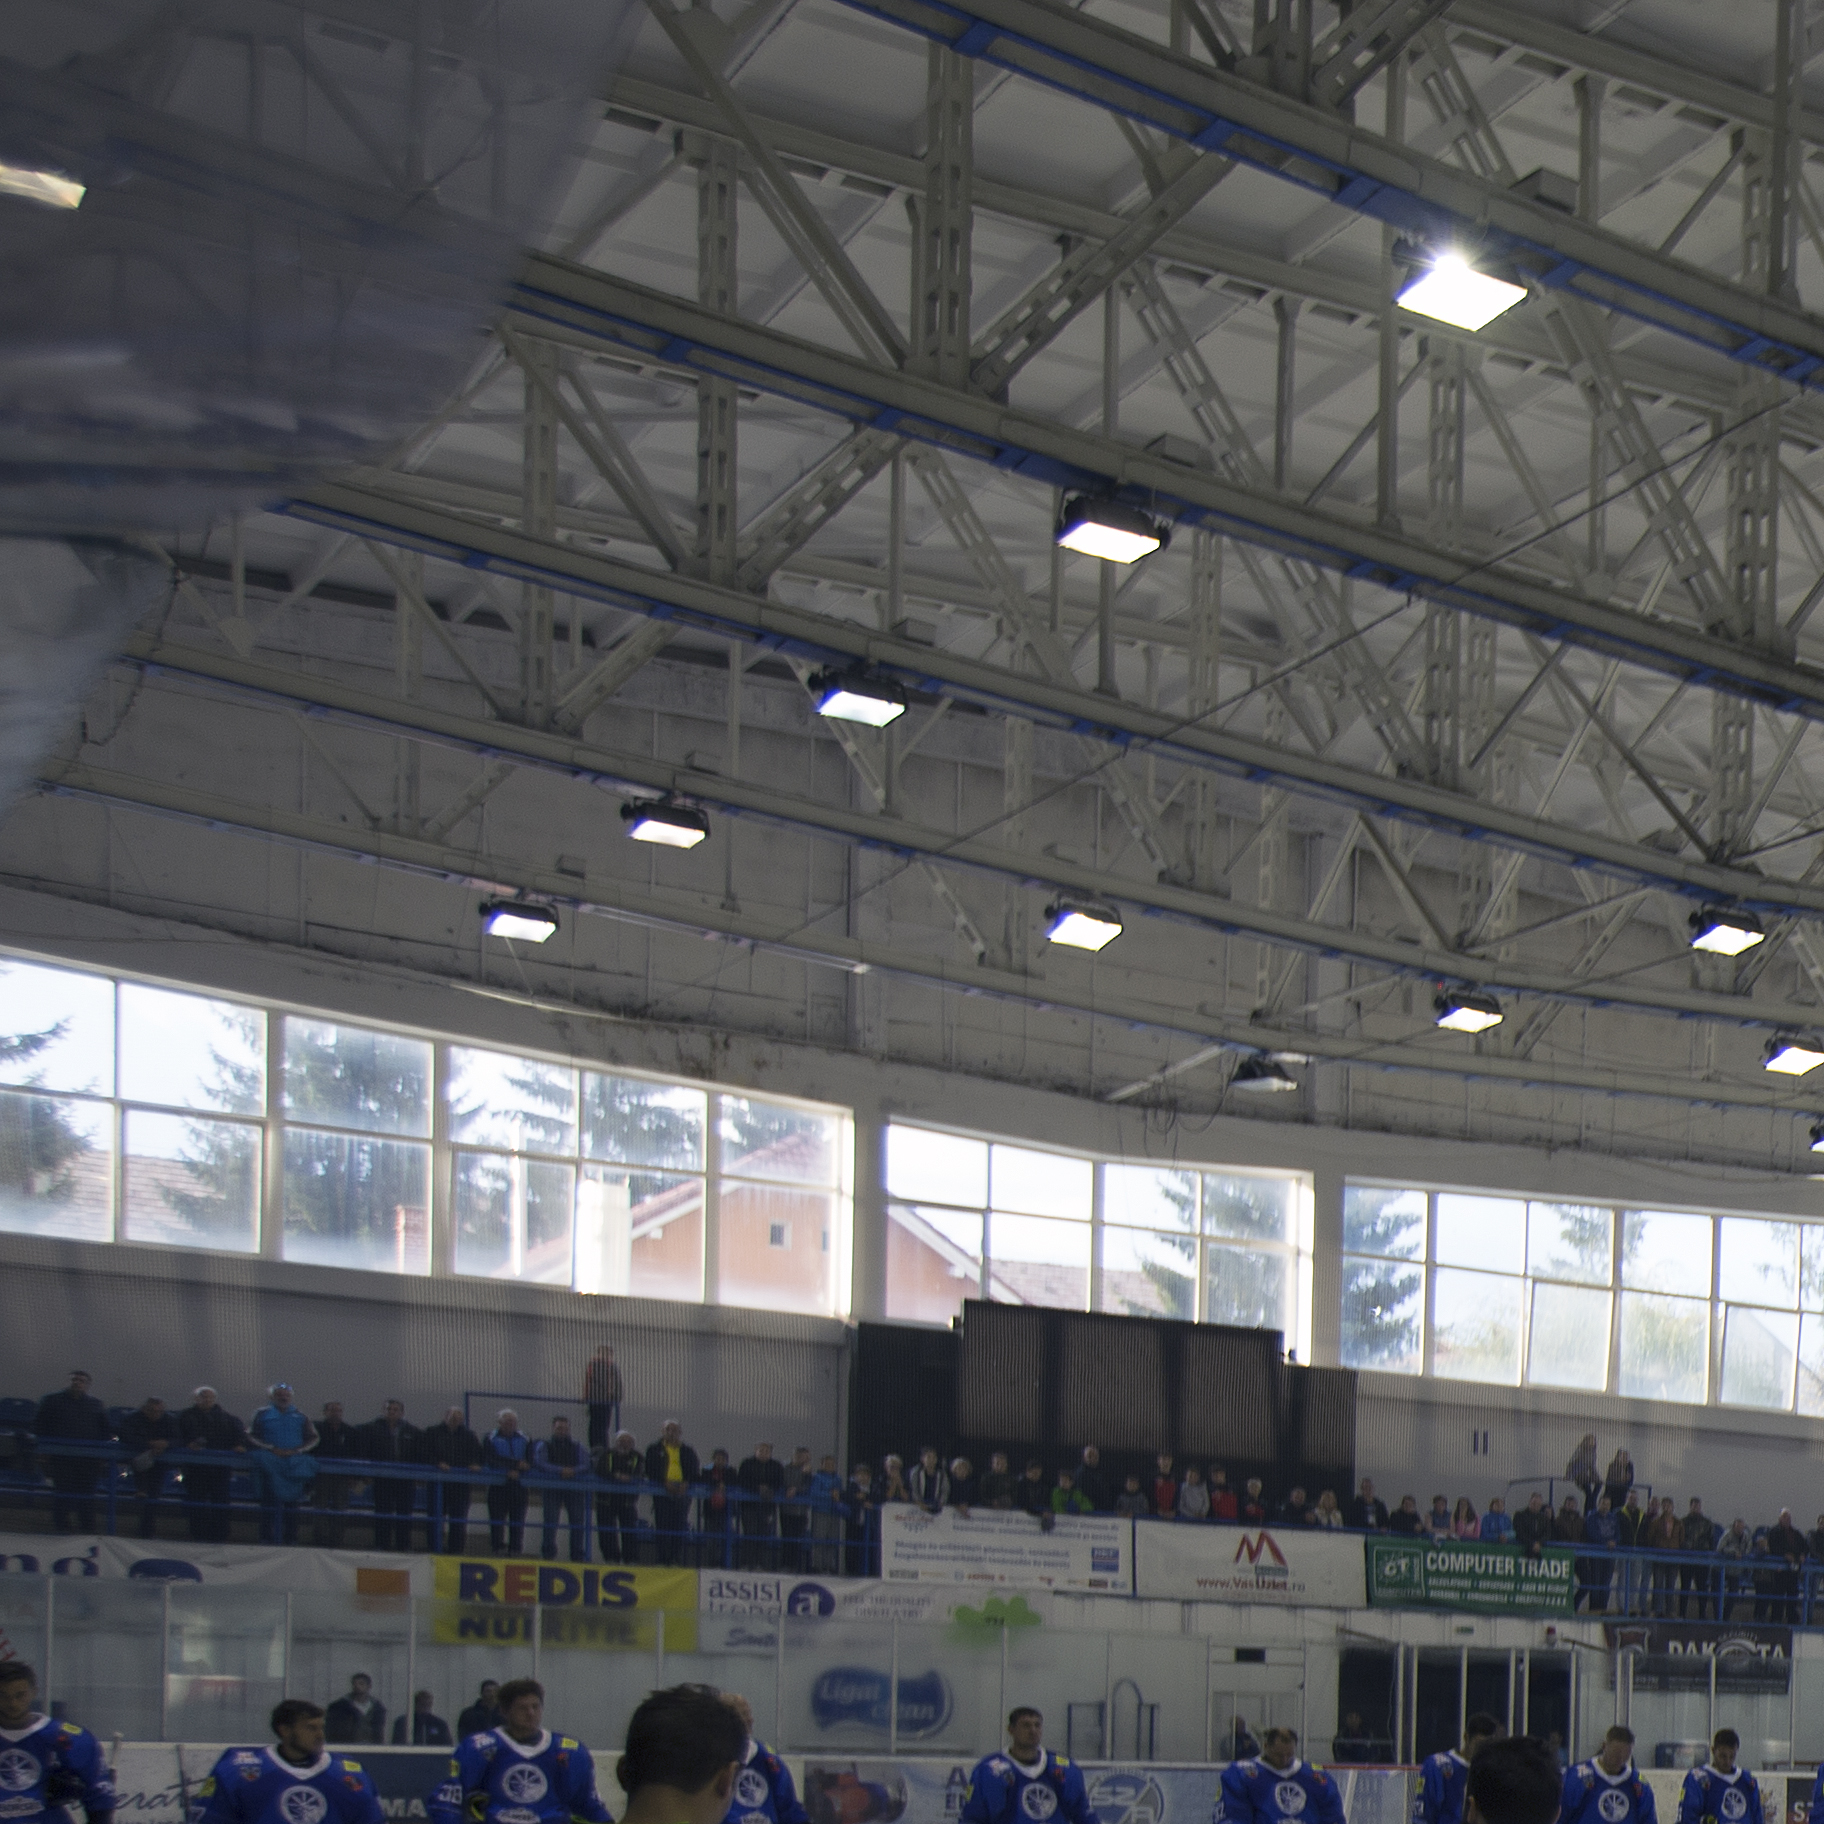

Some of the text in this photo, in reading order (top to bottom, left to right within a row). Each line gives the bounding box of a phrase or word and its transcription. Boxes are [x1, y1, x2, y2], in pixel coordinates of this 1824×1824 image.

[1426, 1551, 1515, 1577] COMPUTER
[1518, 1556, 1571, 1580] TRADE
[459, 1562, 639, 1609] REDIS
